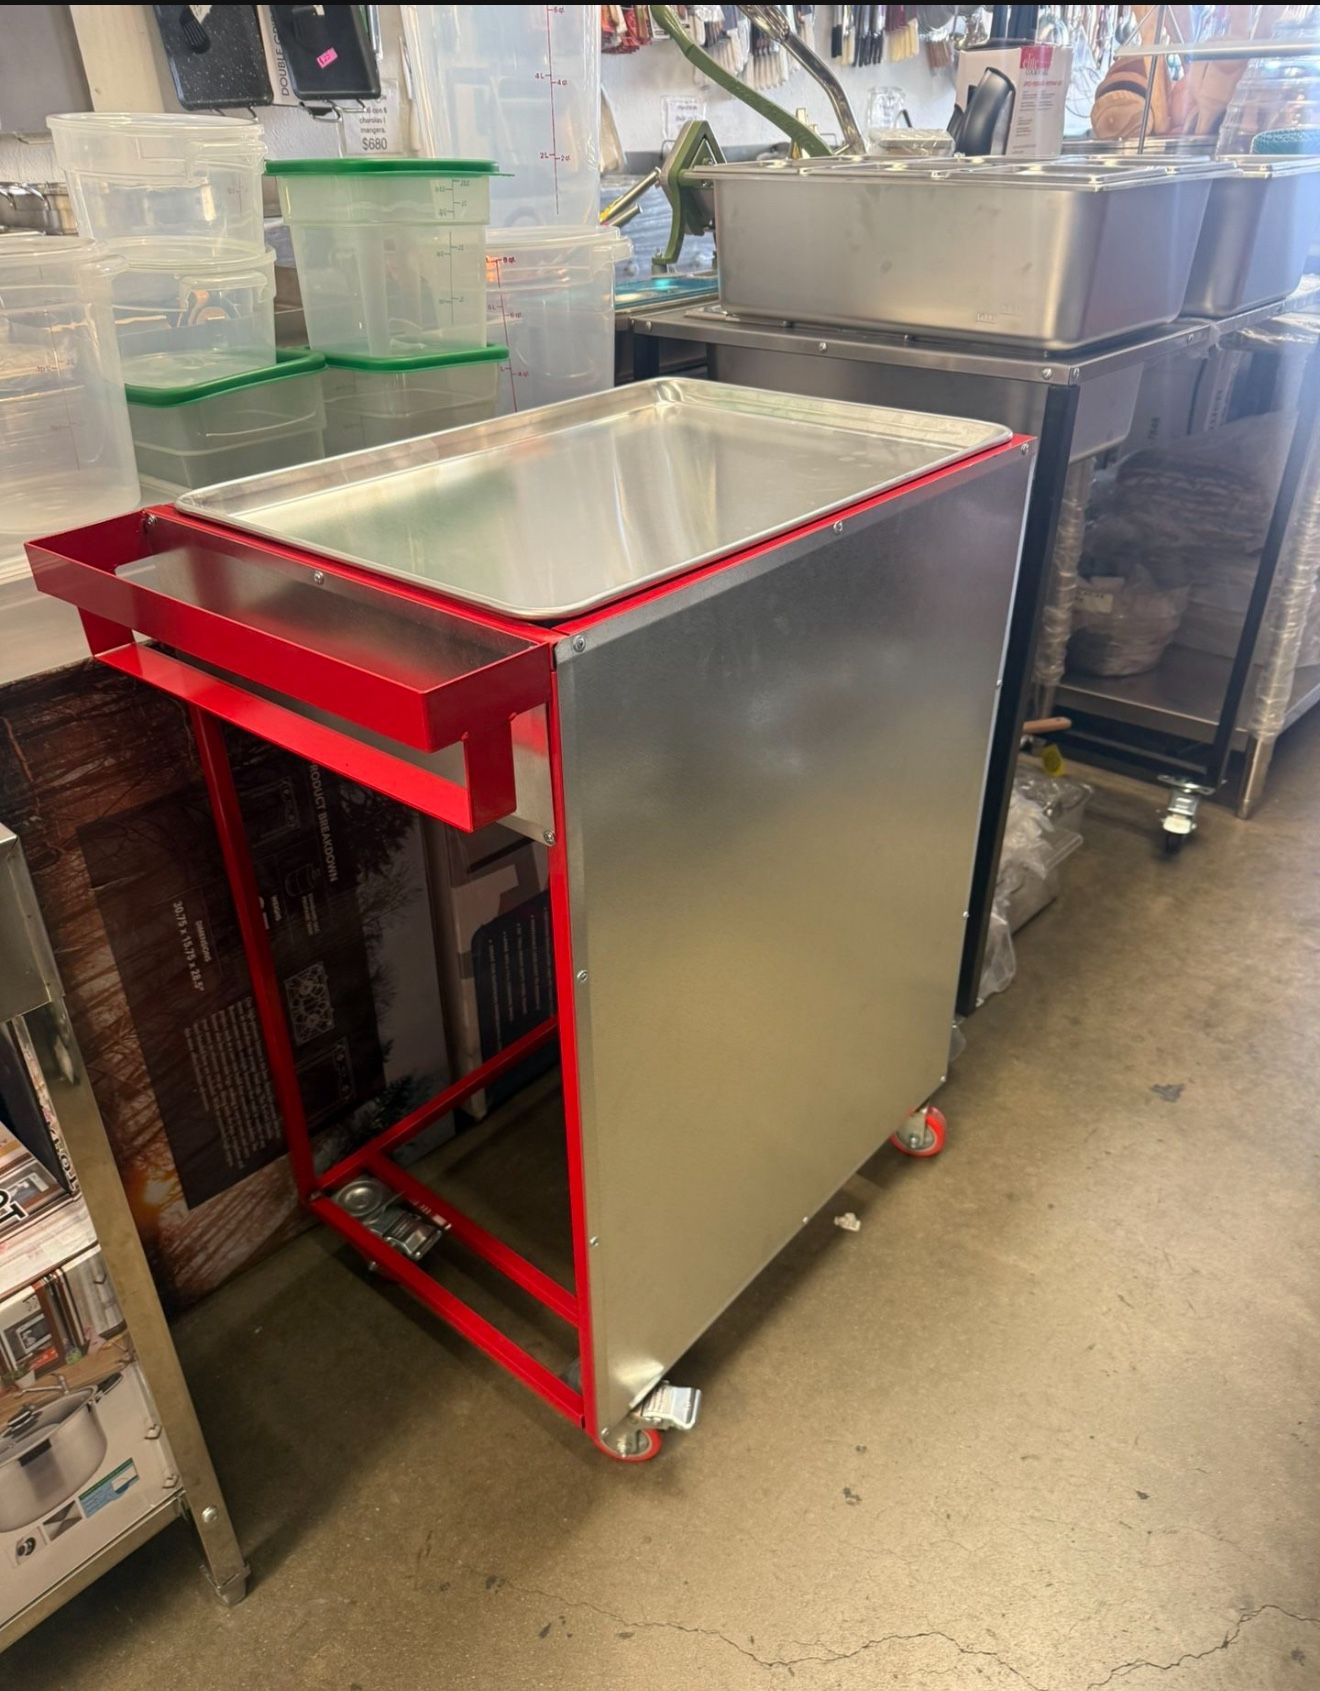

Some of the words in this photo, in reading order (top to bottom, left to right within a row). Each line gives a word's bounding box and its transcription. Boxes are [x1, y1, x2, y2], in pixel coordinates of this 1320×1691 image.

[361, 137, 388, 151] $680
[309, 764, 326, 810] RODUCT
[317, 811, 339, 882] BREAKDOWN
